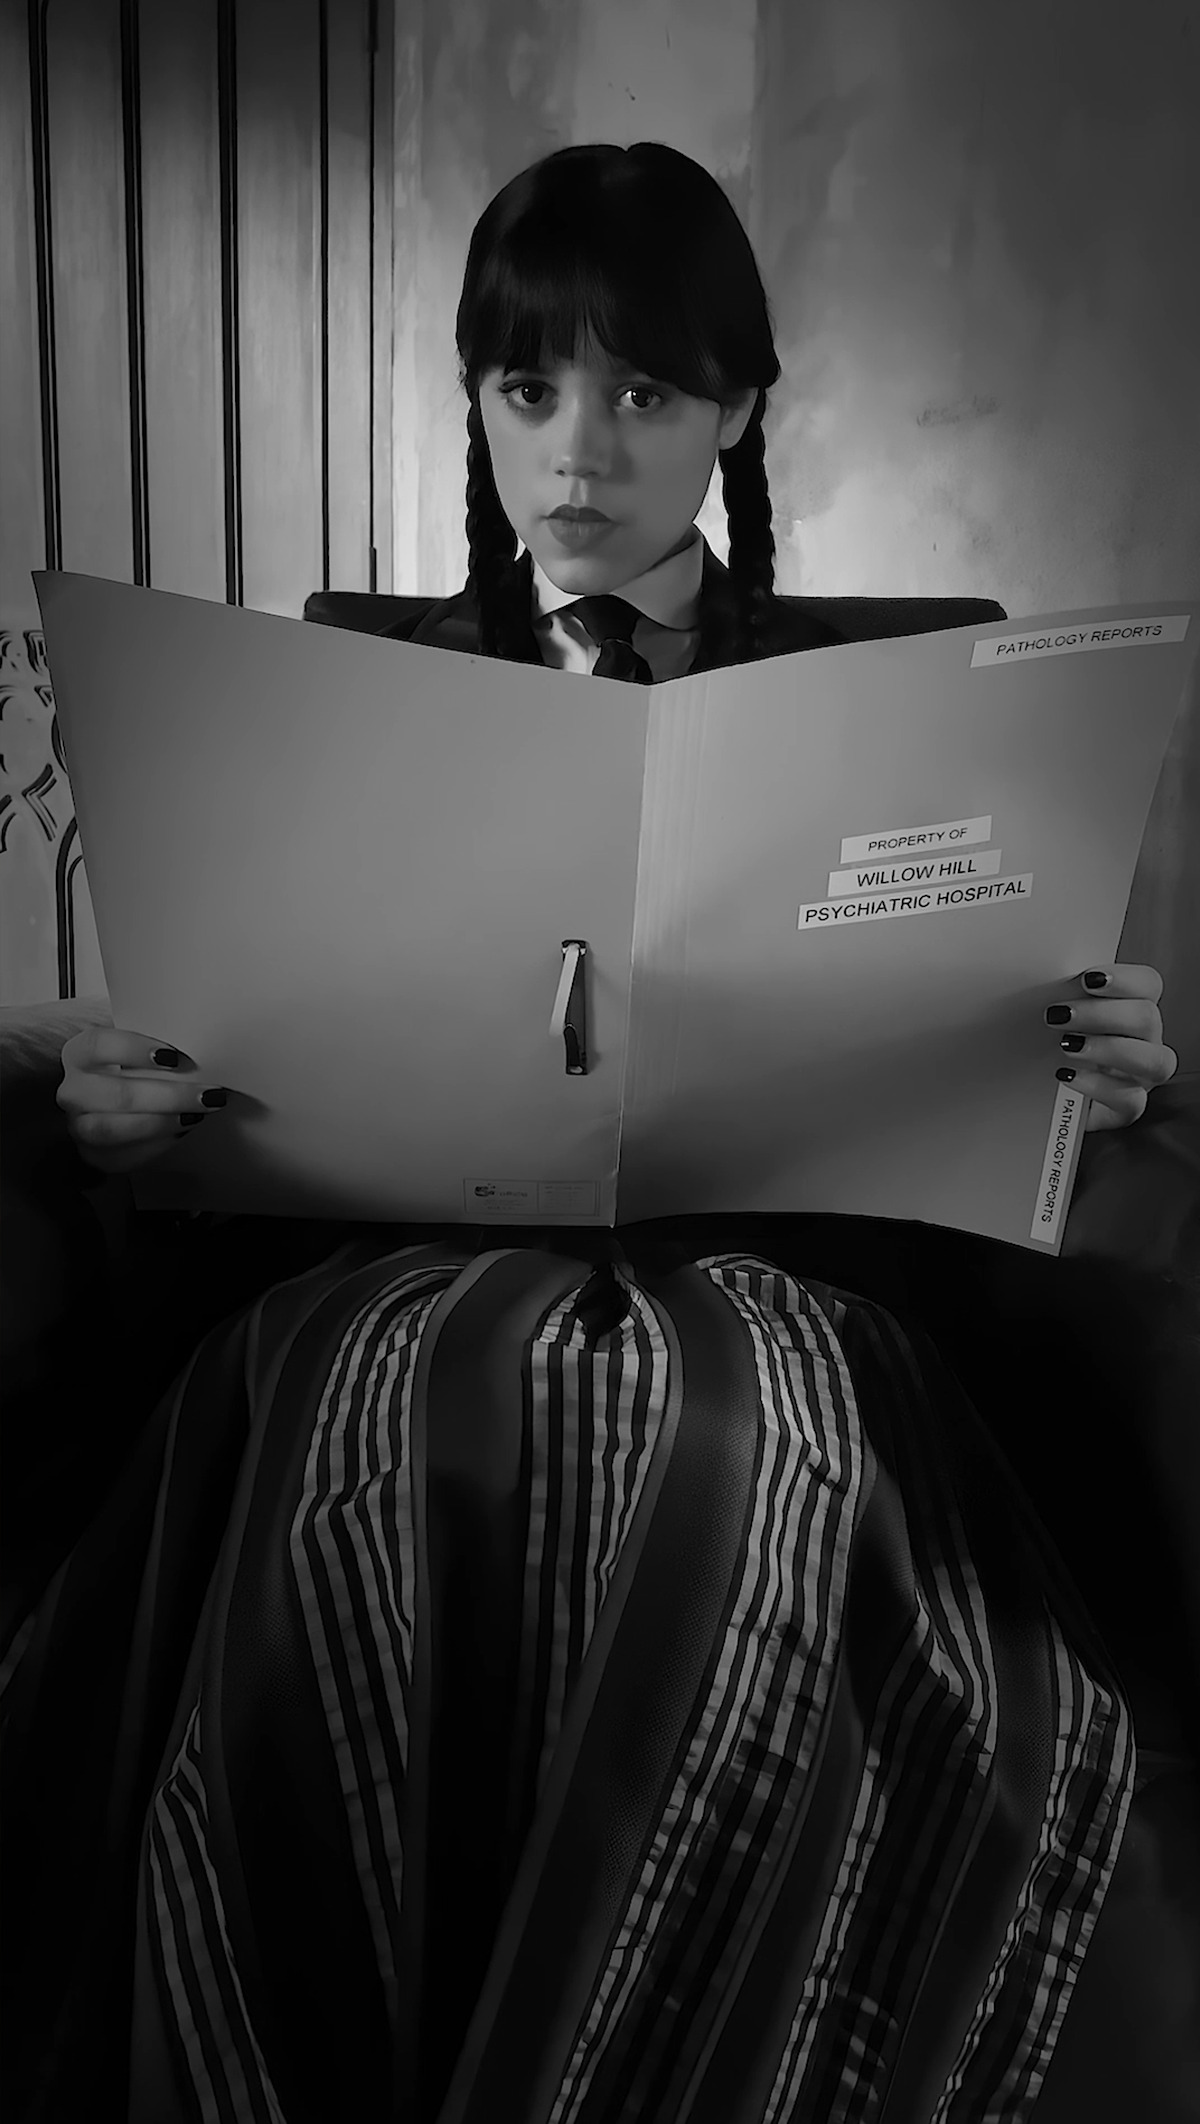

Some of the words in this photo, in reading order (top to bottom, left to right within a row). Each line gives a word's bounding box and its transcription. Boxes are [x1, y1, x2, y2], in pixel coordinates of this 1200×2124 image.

[996, 632, 1089, 656] PATHOLOGY
[1090, 625, 1163, 642] REPORTS
[867, 830, 946, 852] PROPERTY
[949, 827, 969, 840] OF
[857, 864, 936, 887] WILLOW
[939, 859, 977, 876] HILL
[805, 894, 931, 923] PSYCHIATRIC
[937, 880, 1027, 905] HOSPITAL
[1053, 1099, 1075, 1168] PATHOLOGY
[1041, 1168, 1061, 1223] REPORTS
